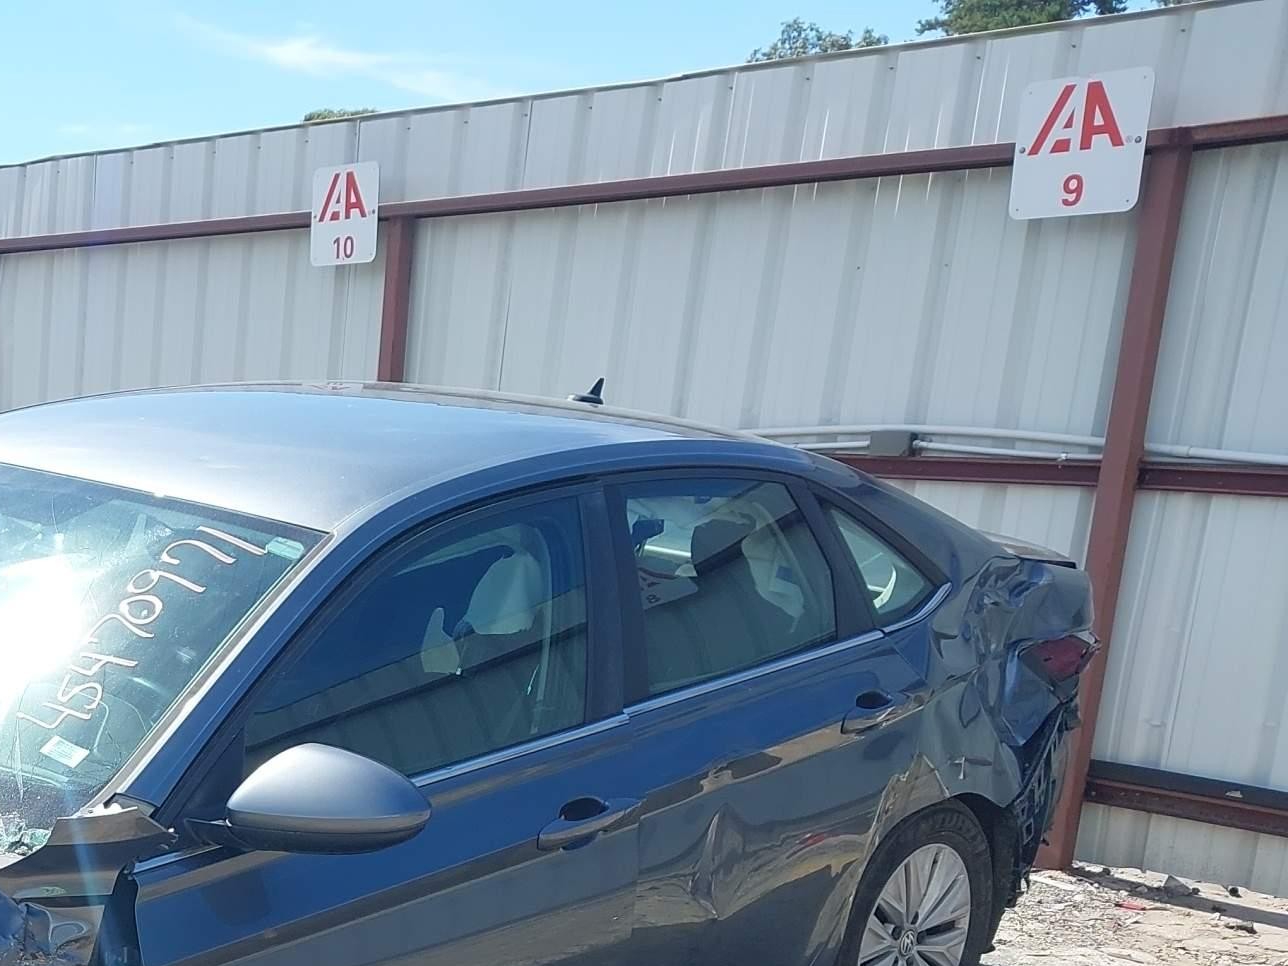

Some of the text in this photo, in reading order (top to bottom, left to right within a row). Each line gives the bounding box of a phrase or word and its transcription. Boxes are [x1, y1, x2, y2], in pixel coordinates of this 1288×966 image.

[1062, 174, 1083, 206] 9
[333, 236, 354, 259] 10
[14, 524, 269, 730] 45470971
